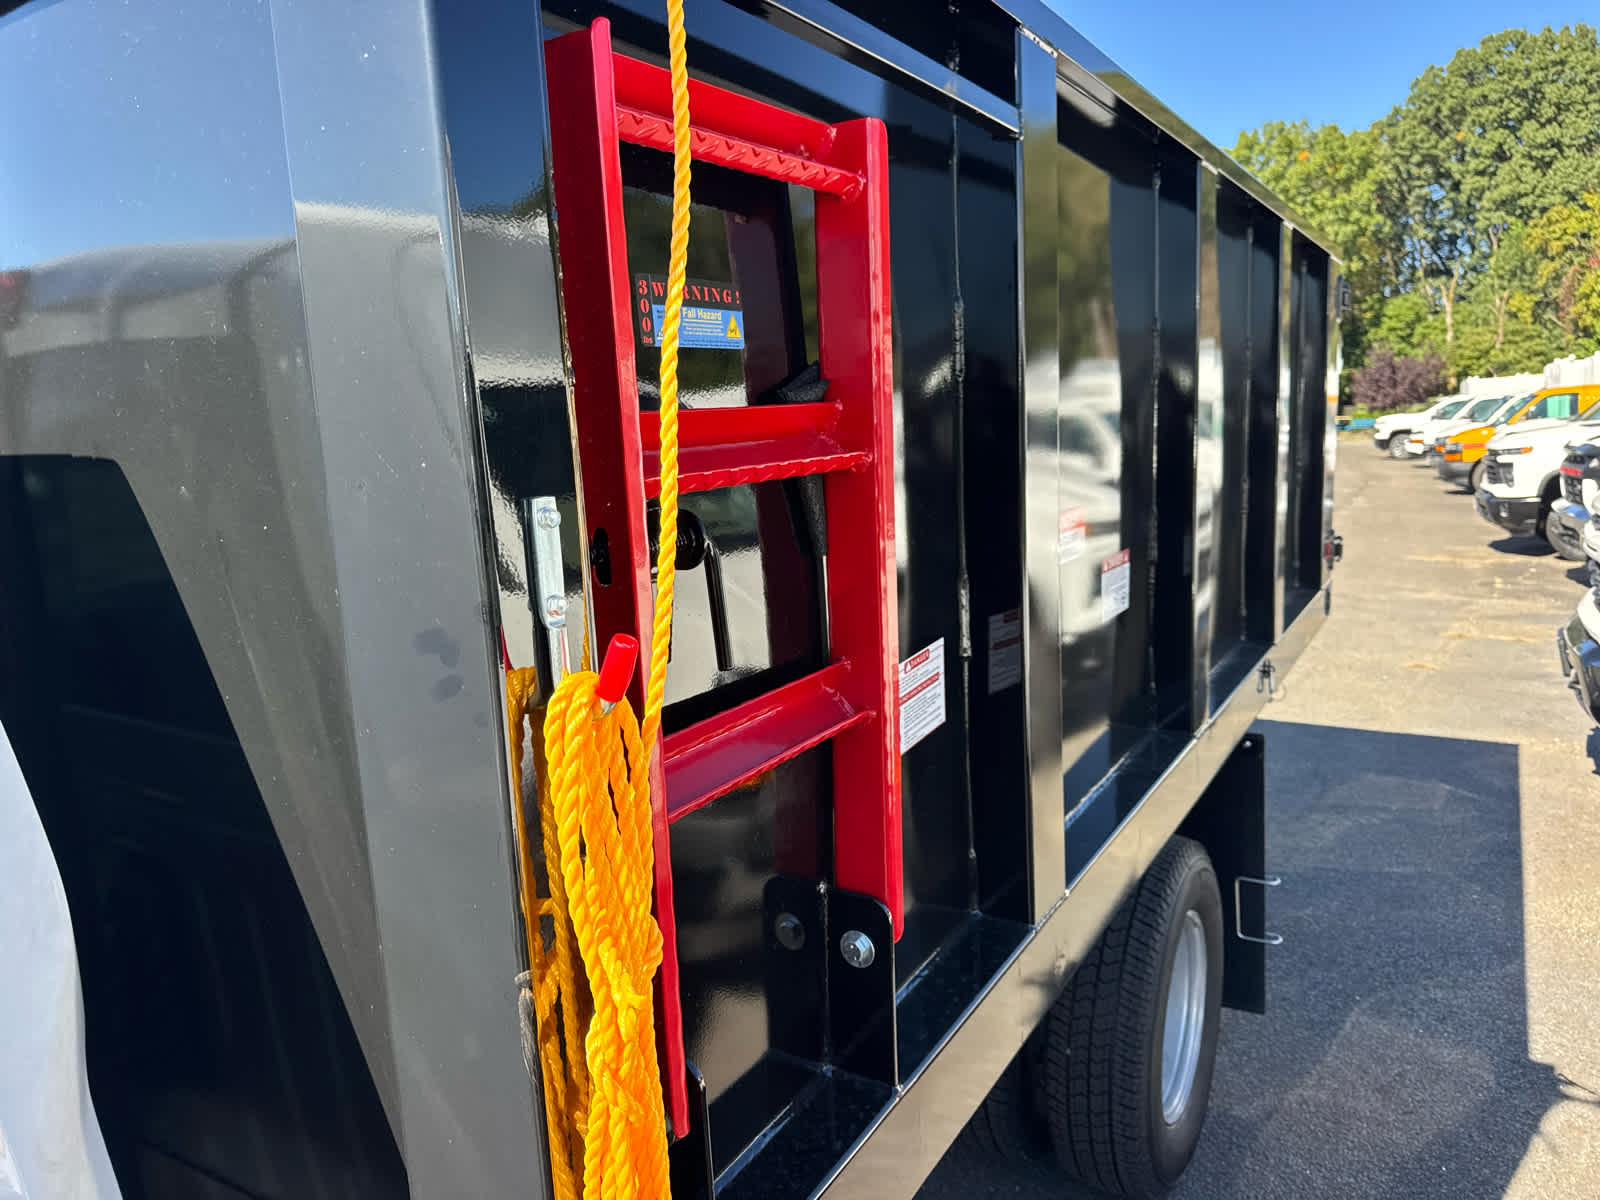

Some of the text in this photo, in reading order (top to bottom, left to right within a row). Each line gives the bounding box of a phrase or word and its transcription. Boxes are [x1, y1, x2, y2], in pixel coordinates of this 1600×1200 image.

[650, 281, 740, 305] WRNING!
[682, 307, 722, 321] Fall Hazard
